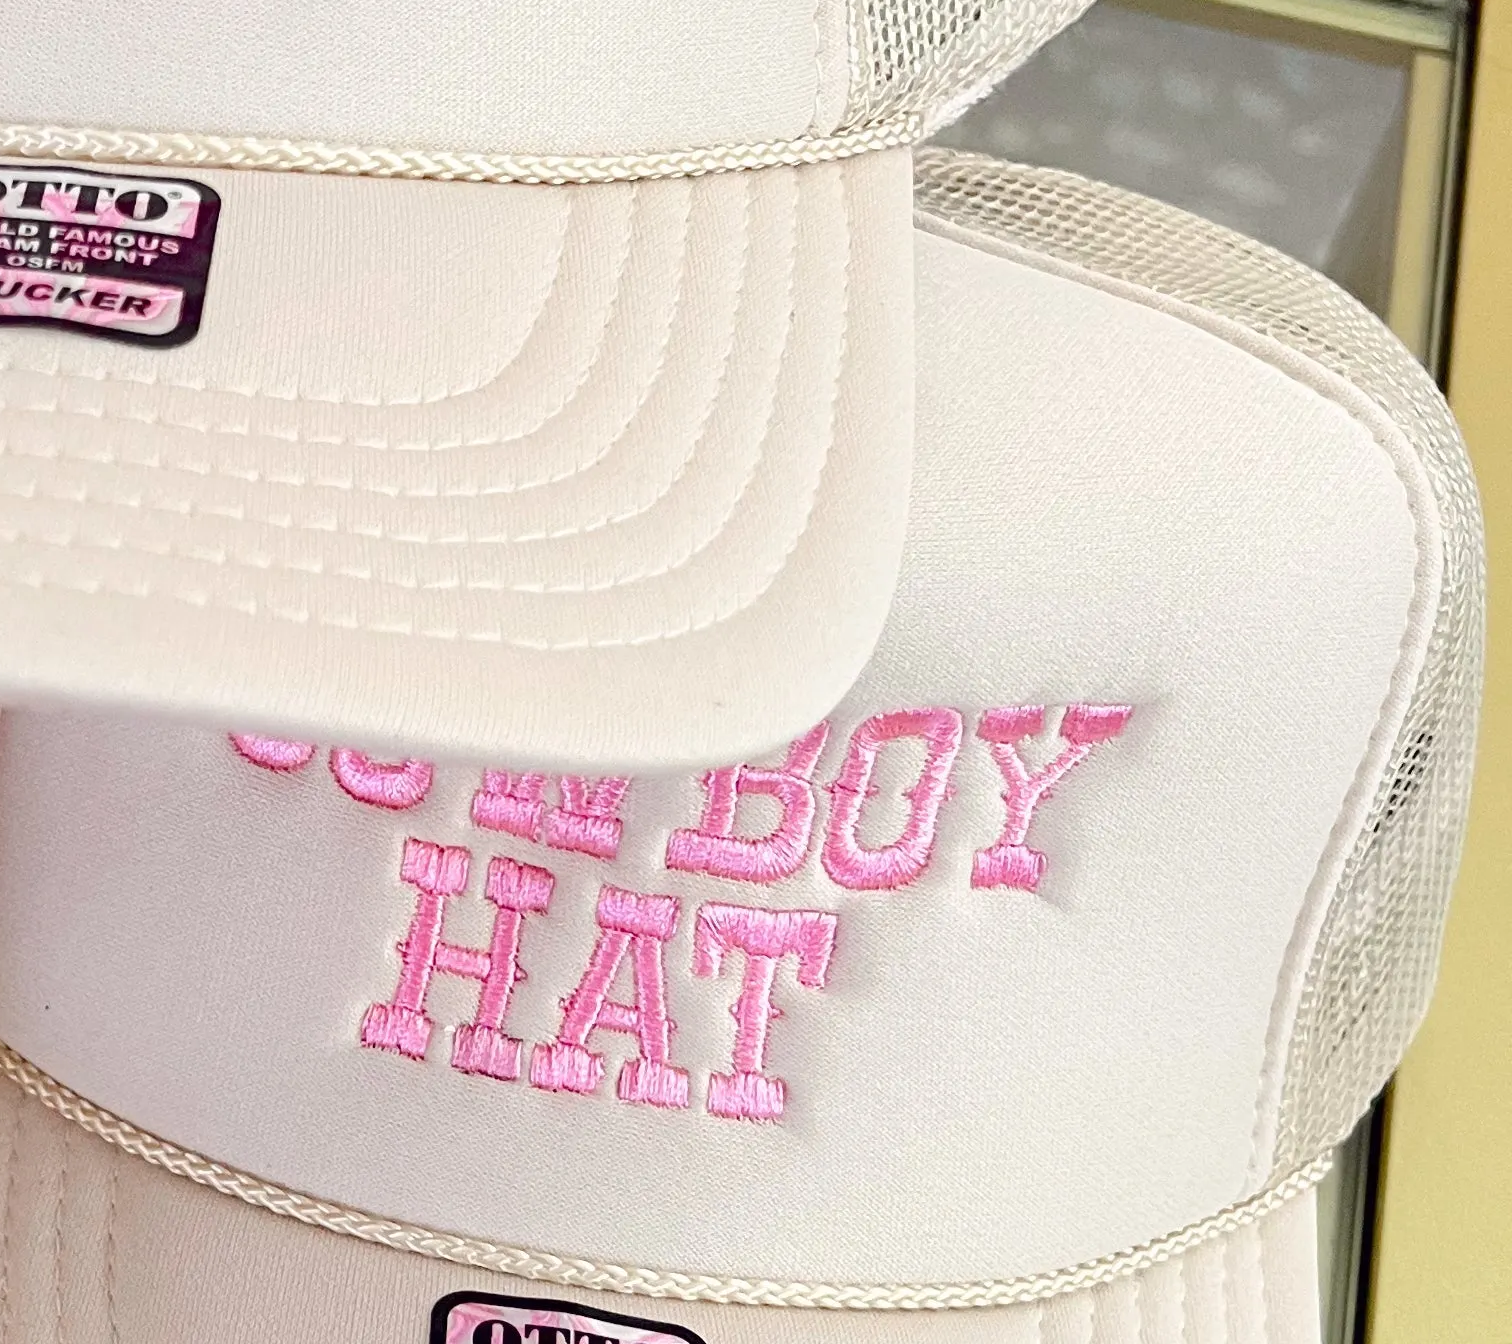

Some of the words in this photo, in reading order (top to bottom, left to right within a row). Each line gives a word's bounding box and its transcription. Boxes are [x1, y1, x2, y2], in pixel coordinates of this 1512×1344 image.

[48, 224, 181, 255] FAMOUS
[50, 242, 160, 266] FRONT
[6, 256, 85, 274] OSFM
[229, 704, 1133, 891] BOY
[359, 837, 839, 1122] HAT
